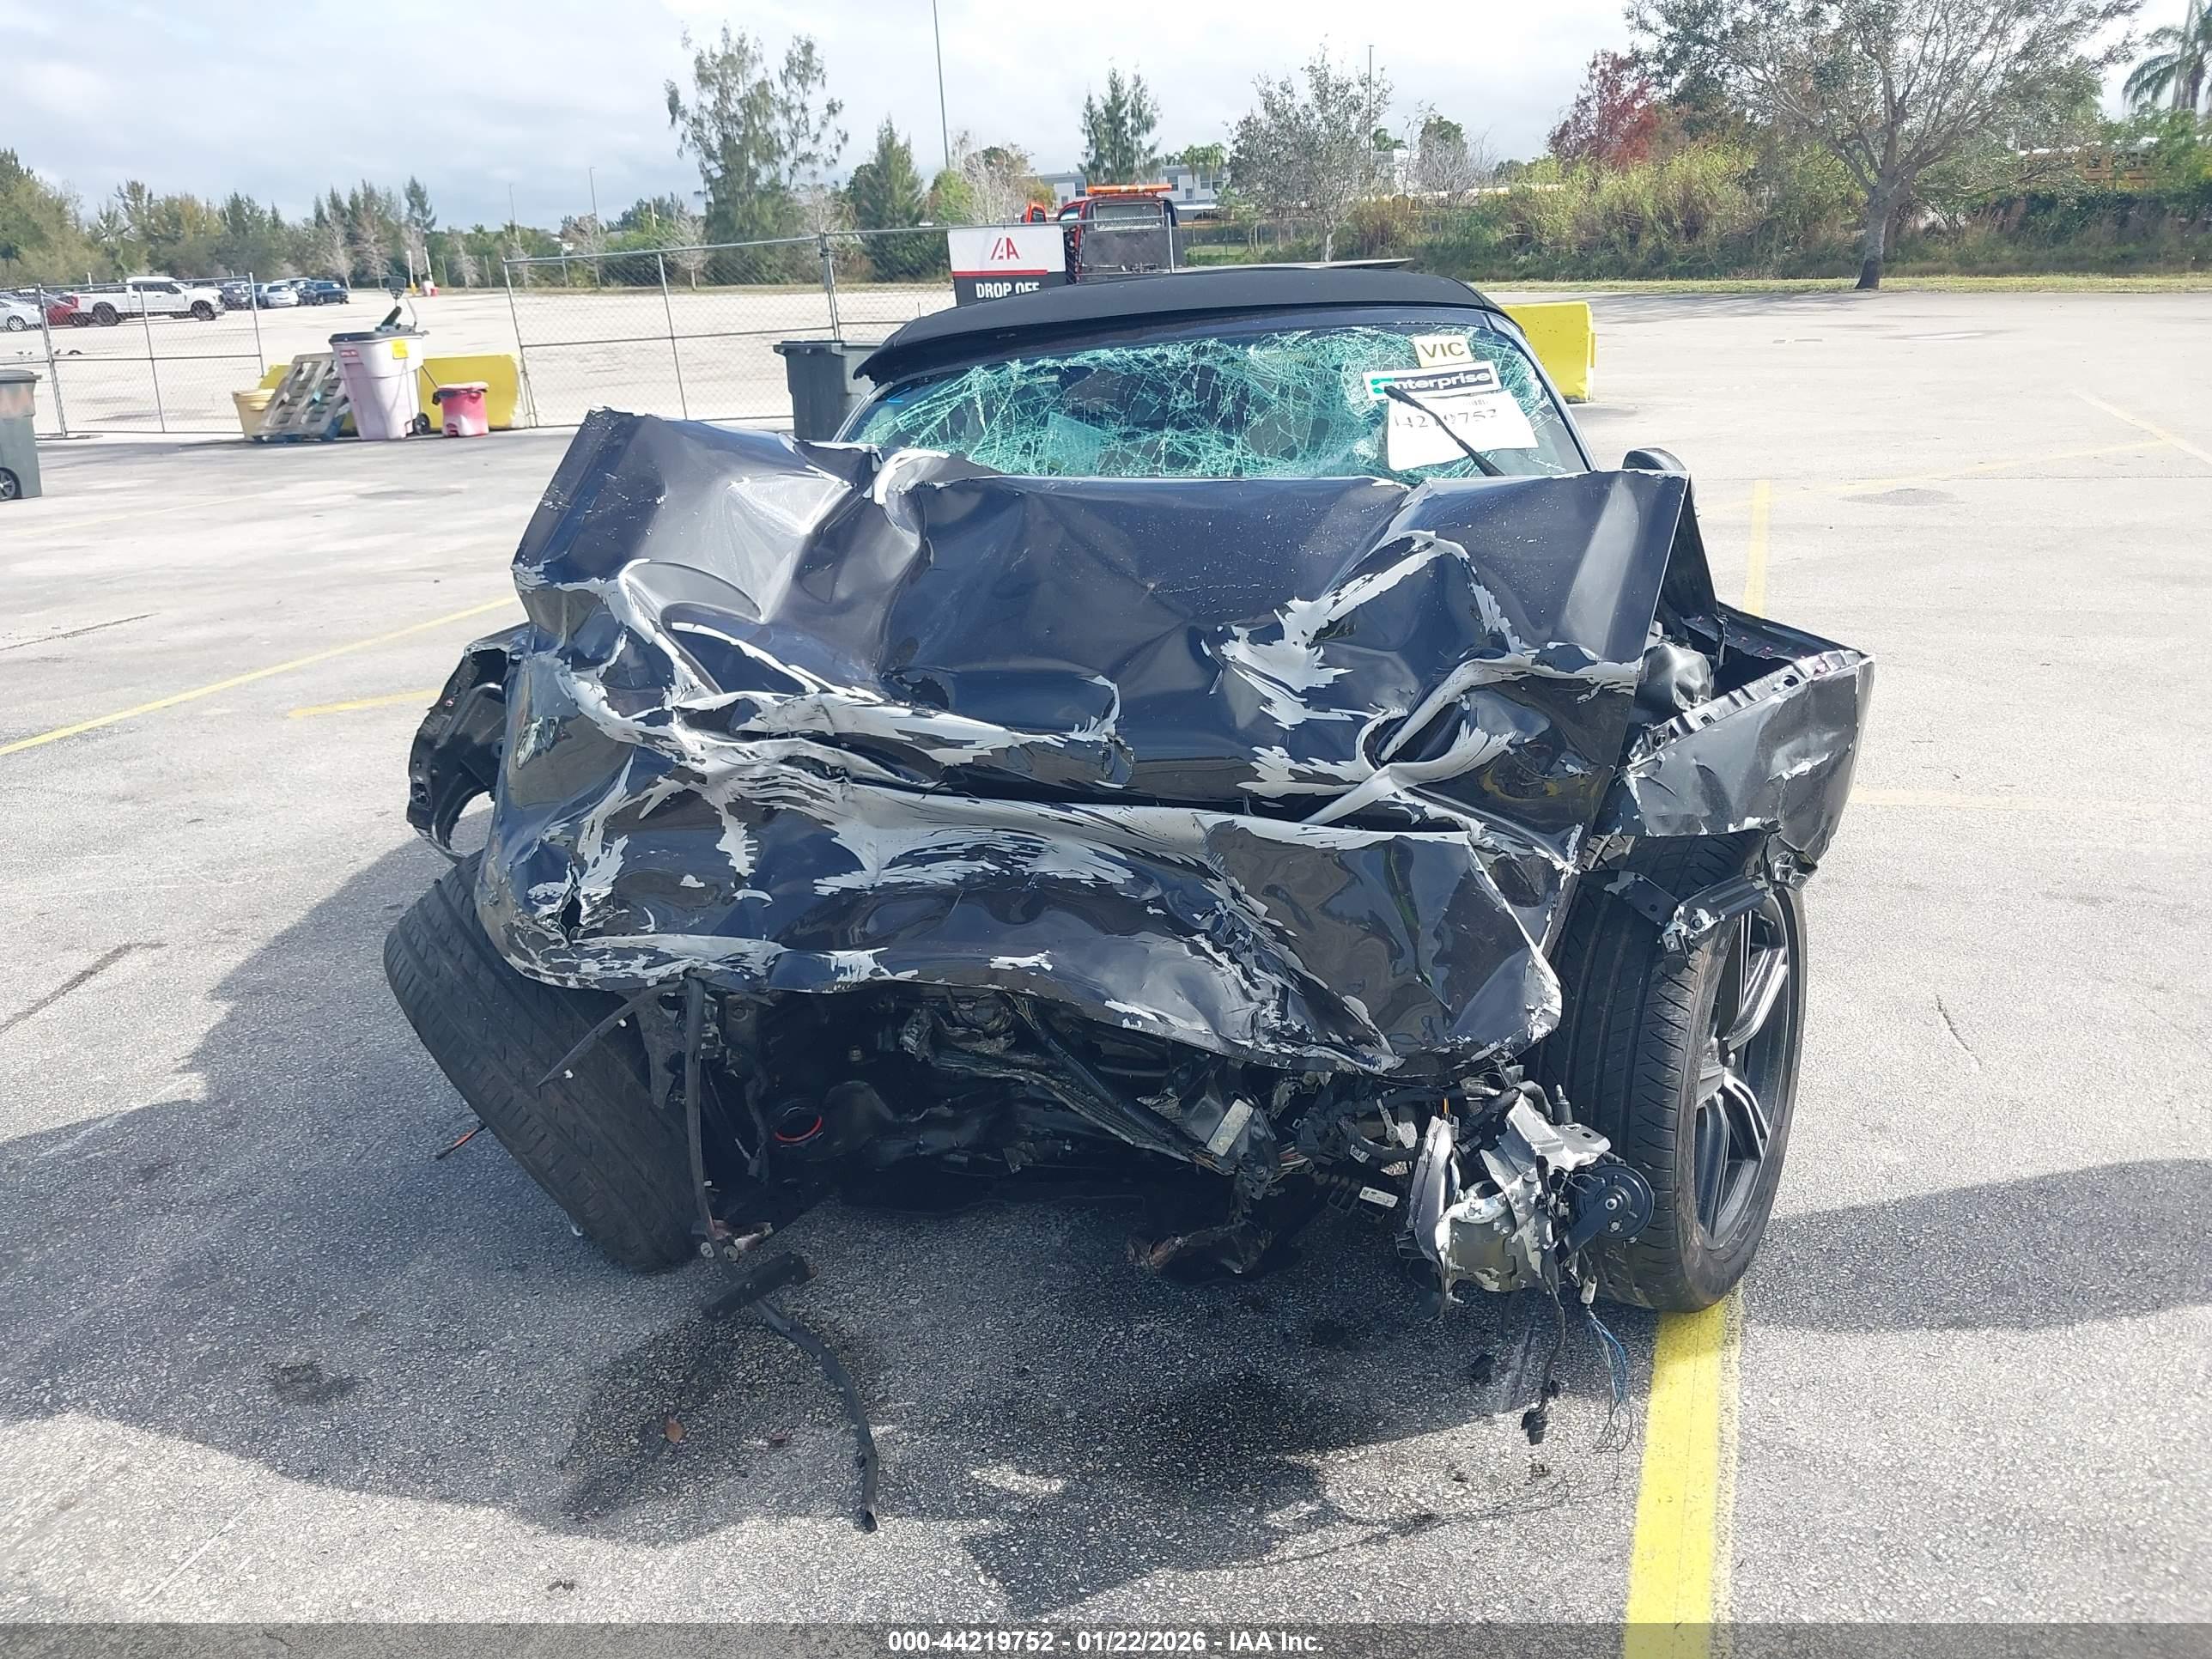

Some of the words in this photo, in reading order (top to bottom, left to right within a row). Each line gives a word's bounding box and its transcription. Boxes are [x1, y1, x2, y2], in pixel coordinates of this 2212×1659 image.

[975, 283, 1012, 298] DROP
[1420, 343, 1465, 357] VIC
[1395, 409, 1498, 428] 429752
